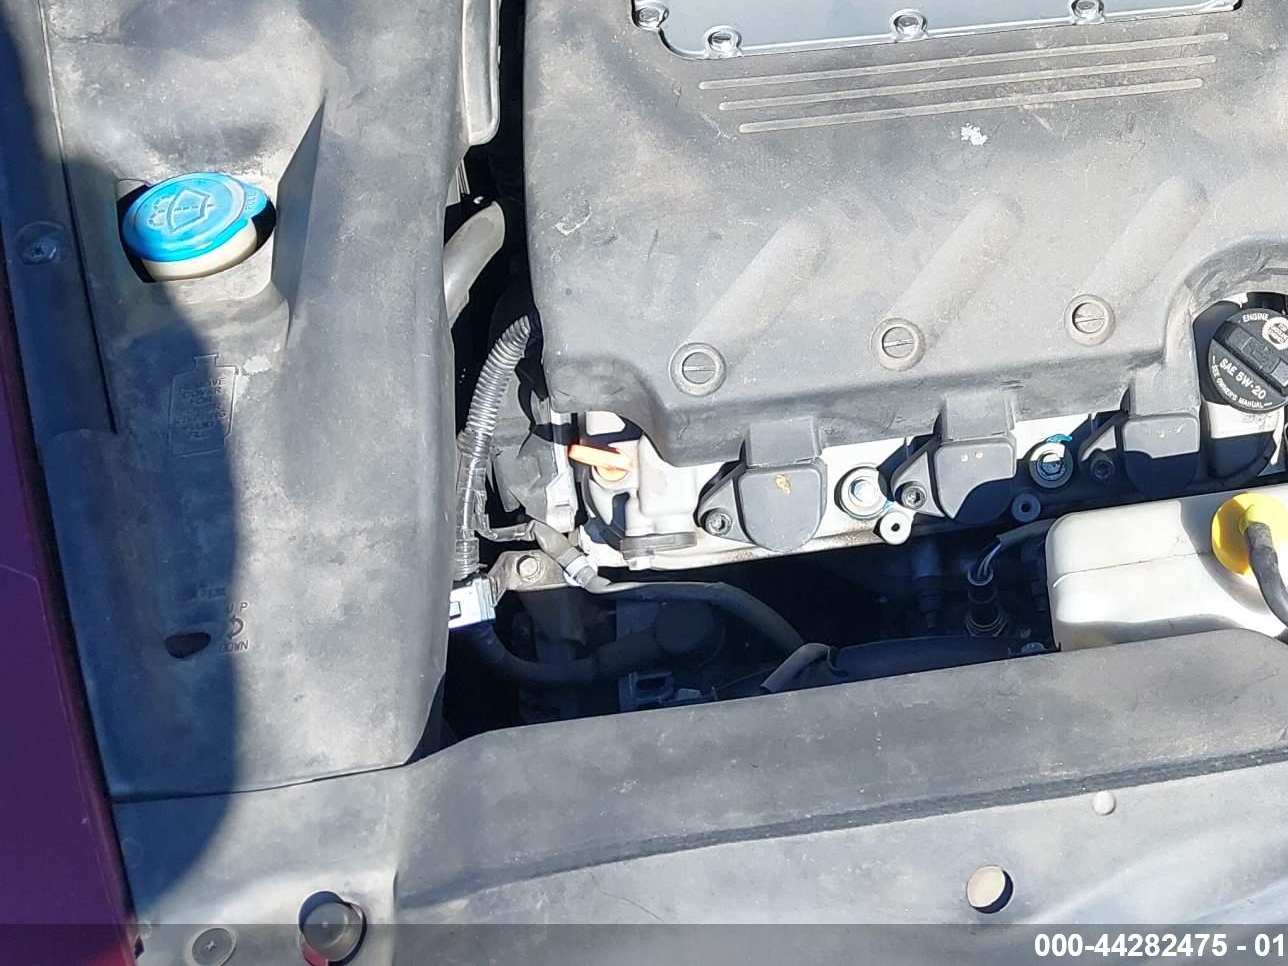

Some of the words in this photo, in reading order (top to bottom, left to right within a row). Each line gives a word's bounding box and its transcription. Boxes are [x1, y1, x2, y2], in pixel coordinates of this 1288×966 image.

[1242, 313, 1269, 323] ENGINE
[1219, 358, 1238, 377] SAE
[1238, 397, 1264, 409] MANUAL
[224, 601, 249, 614] UP
